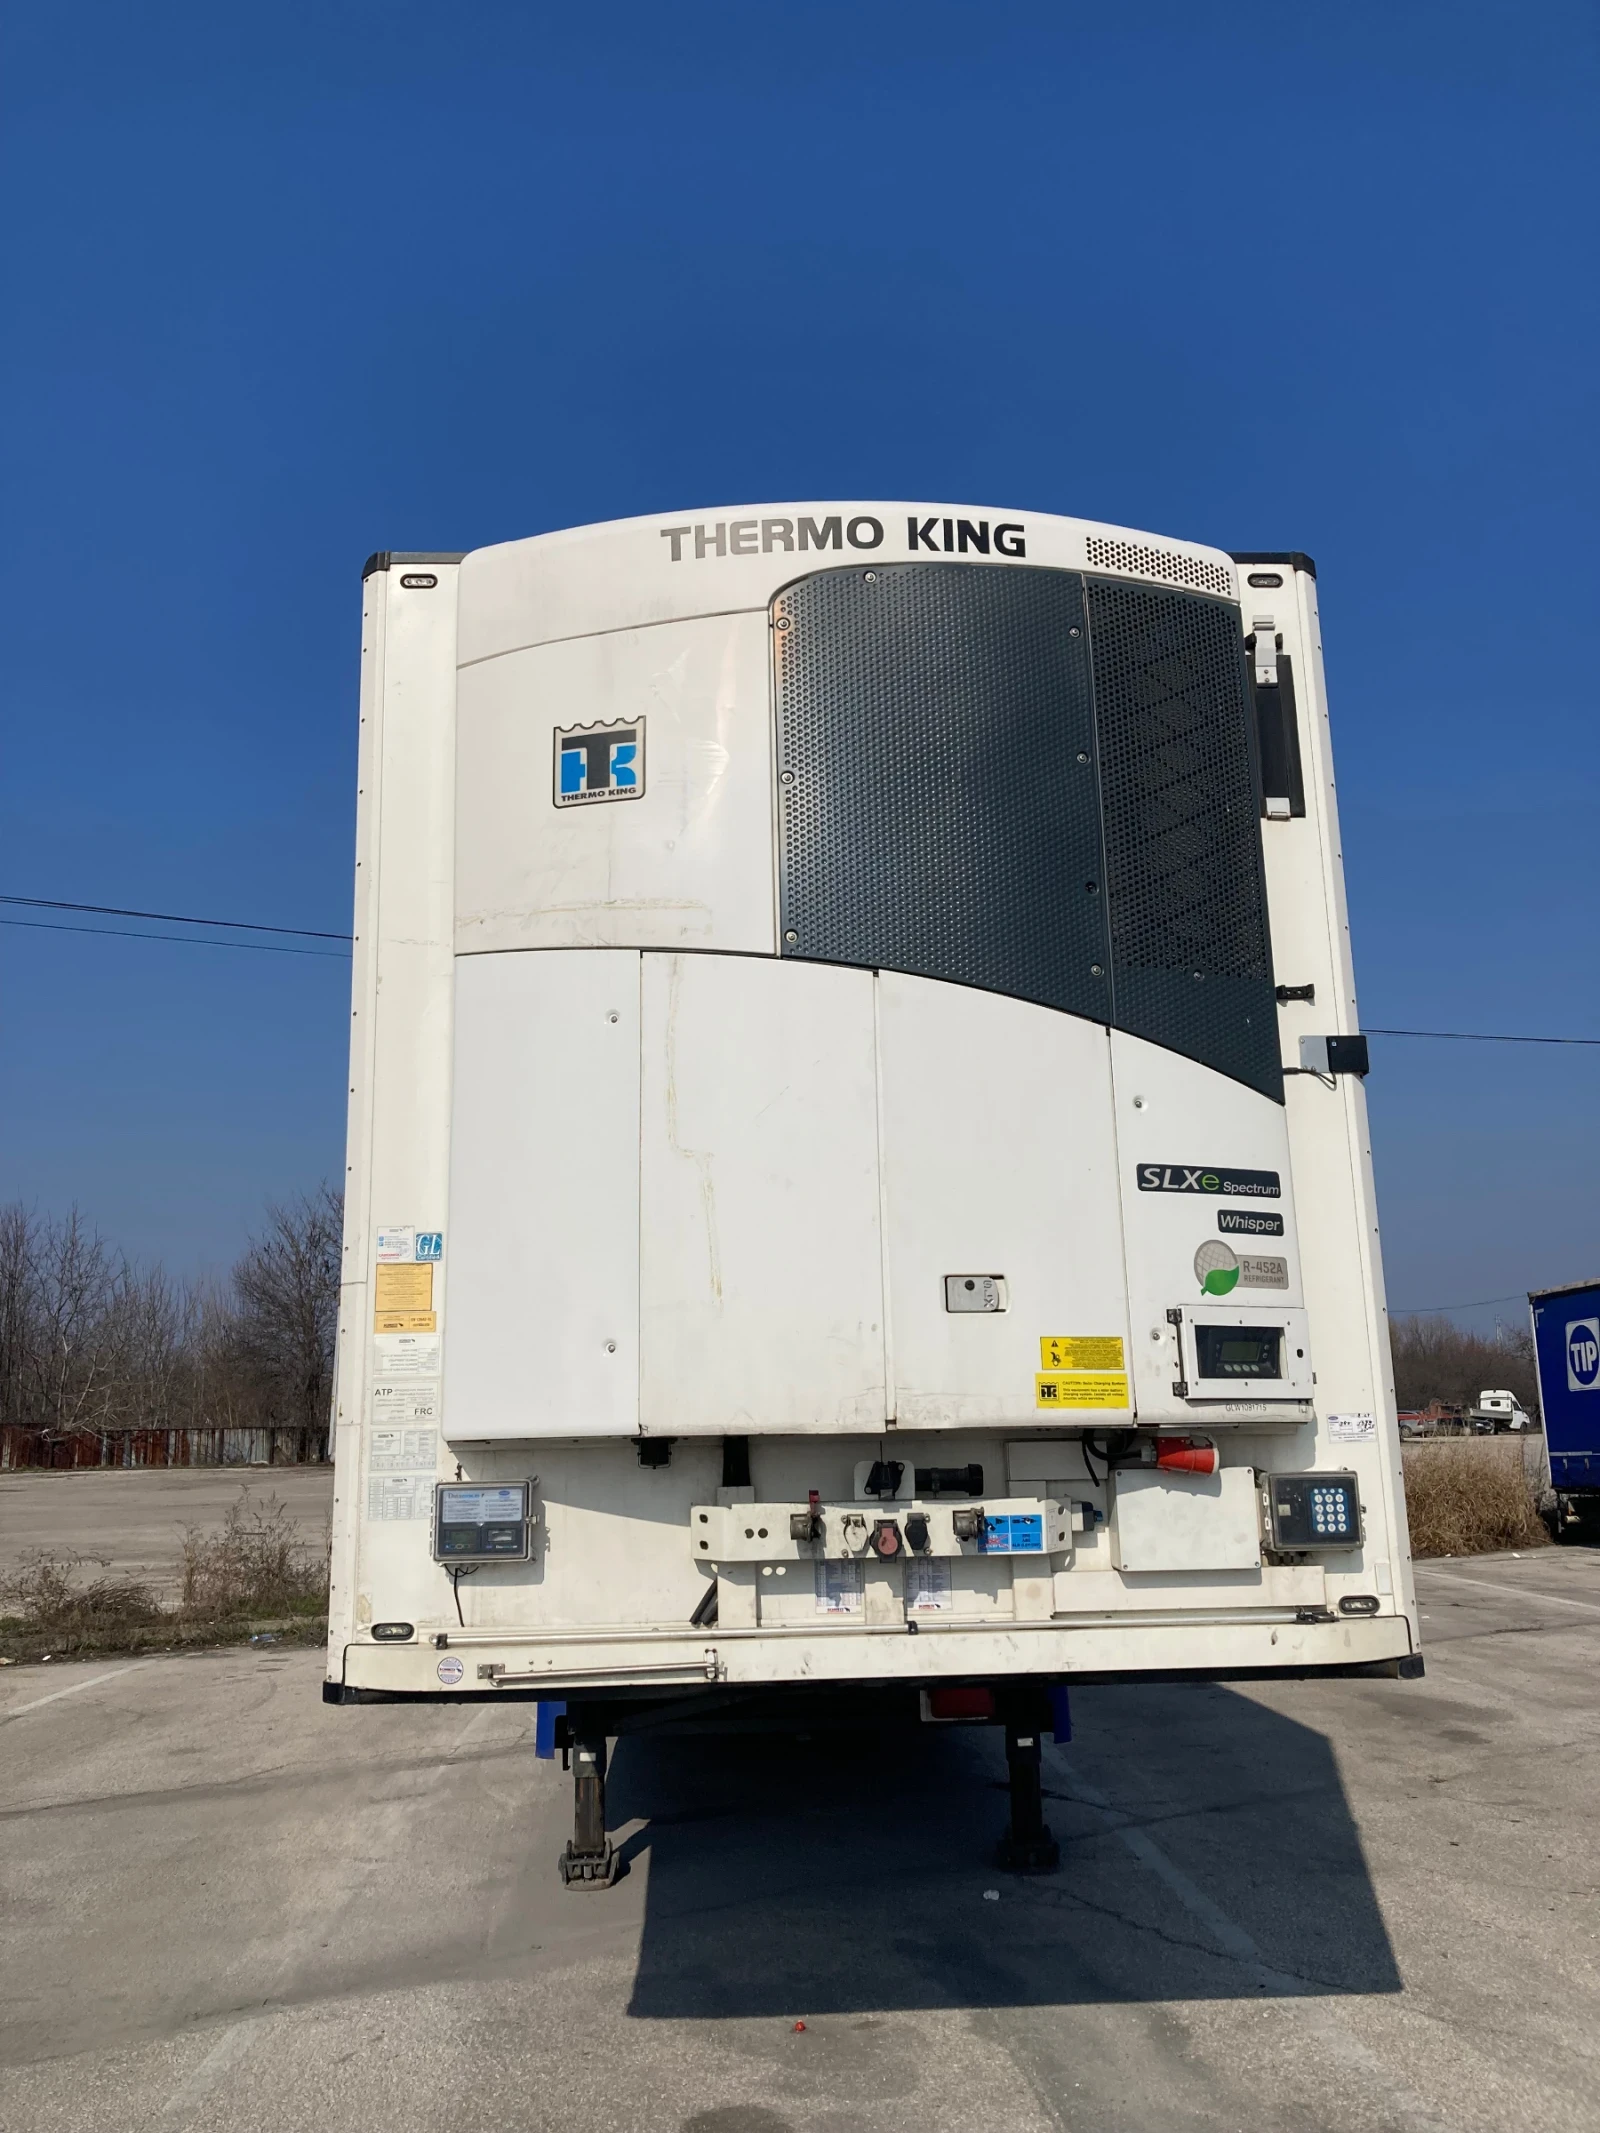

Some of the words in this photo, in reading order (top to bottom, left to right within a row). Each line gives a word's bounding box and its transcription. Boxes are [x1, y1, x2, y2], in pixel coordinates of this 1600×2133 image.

[660, 516, 884, 562] THERMO
[907, 516, 1027, 558] KING
[561, 790, 605, 802] THERMO
[608, 787, 637, 796] KING
[1141, 1168, 1220, 1191] SLXe
[1223, 1181, 1279, 1195] Spectrum
[1220, 1214, 1280, 1232] Whisper
[417, 1234, 440, 1255] GL
[1243, 1260, 1283, 1274] R-452A
[1244, 1274, 1285, 1284] REFRIGERANT
[1570, 1341, 1598, 1372] TIP
[374, 1388, 393, 1396] ATP
[414, 1407, 433, 1415] FRC
